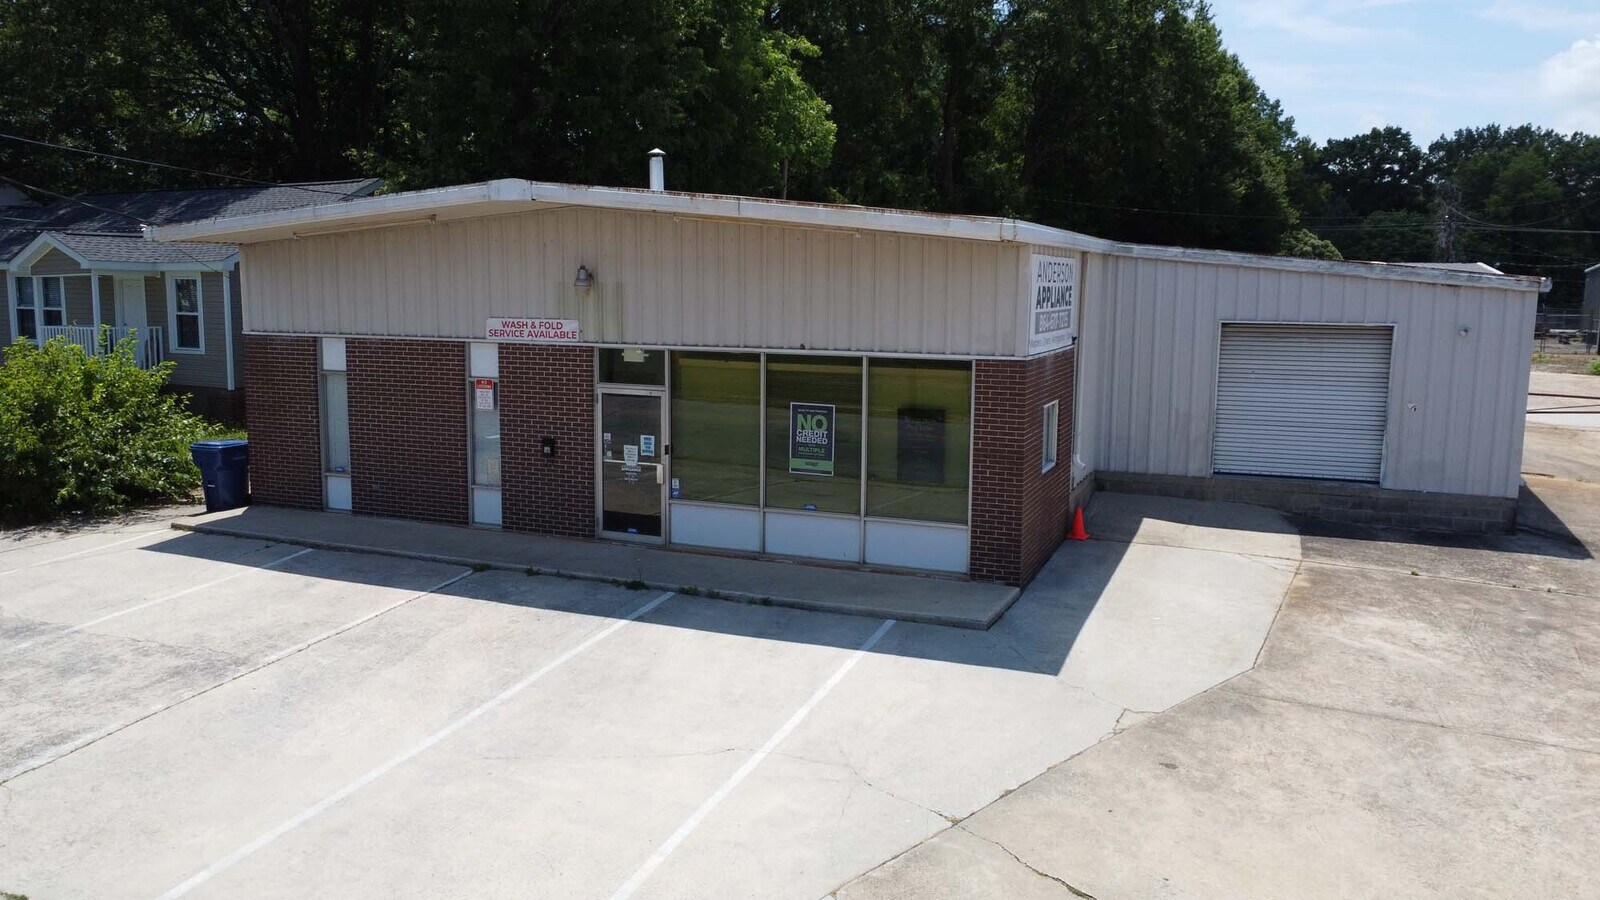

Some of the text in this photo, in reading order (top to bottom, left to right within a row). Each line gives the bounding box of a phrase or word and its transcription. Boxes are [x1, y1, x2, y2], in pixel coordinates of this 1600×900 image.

[1036, 261, 1074, 283] ANDERSON
[1036, 285, 1072, 309] APPLIANCE
[501, 321, 563, 330] WASH & FOLD
[488, 329, 577, 339] SERVICE AVAILABLE
[797, 413, 828, 432] NO
[796, 429, 828, 438] CREDIT
[796, 436, 828, 445] NEEDED
